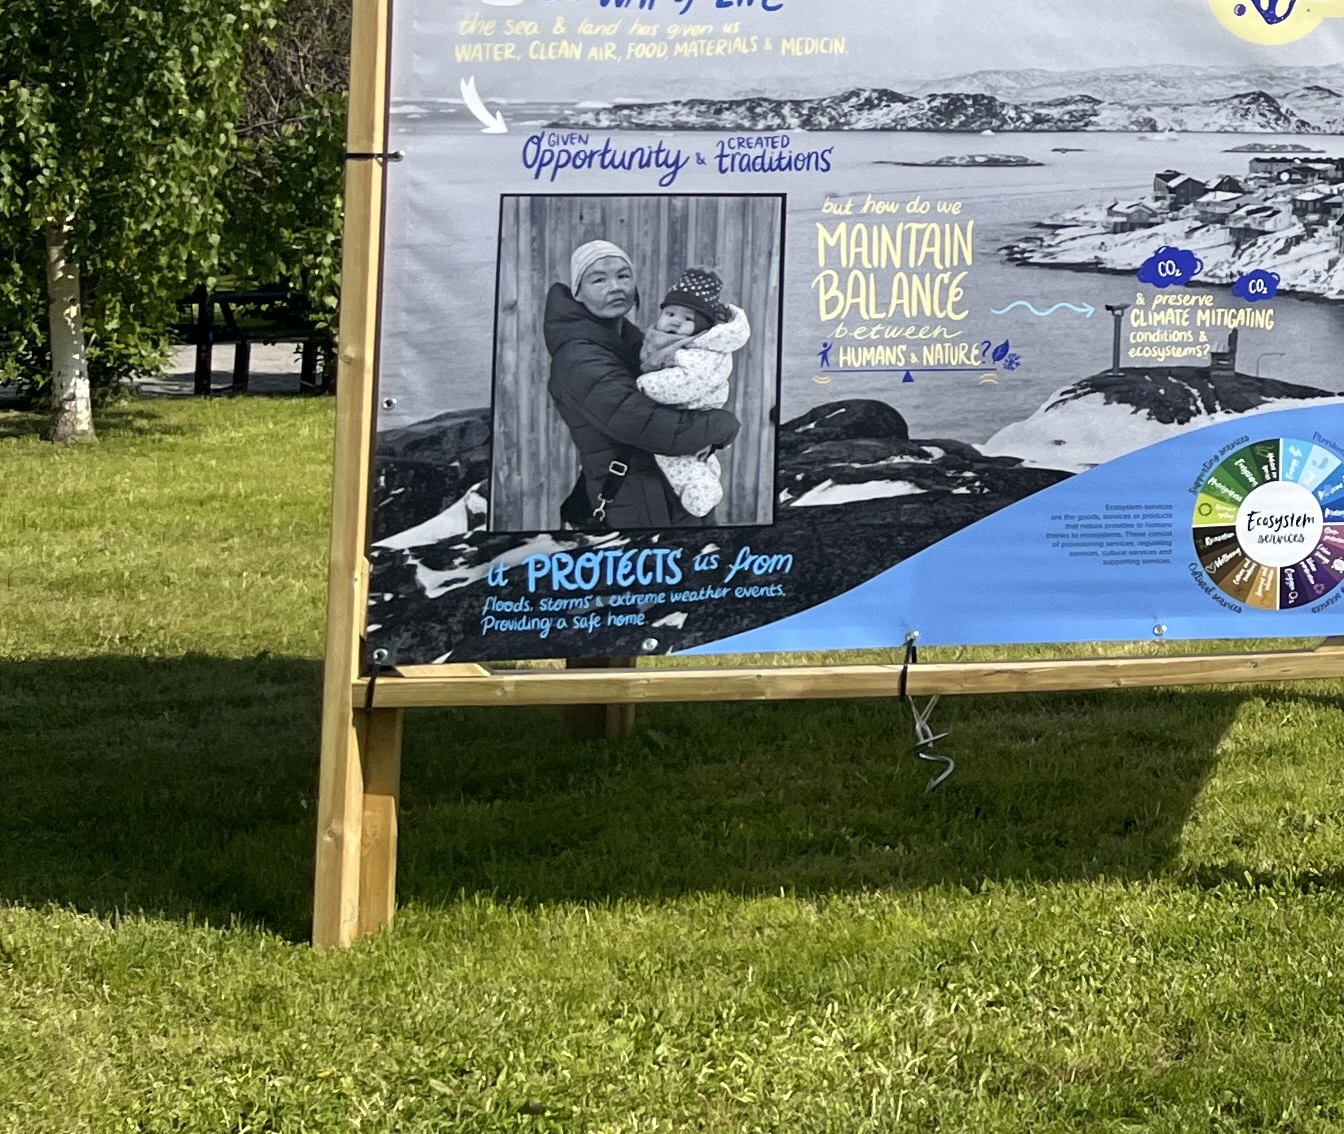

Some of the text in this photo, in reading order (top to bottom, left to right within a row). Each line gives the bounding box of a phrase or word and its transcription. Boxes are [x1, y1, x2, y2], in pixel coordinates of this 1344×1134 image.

[459, 11, 741, 41] the sea & land has given us
[455, 41, 521, 62] WATER,
[529, 40, 583, 61] CLEAN
[674, 35, 758, 59] MATERIALS
[763, 37, 773, 51] &
[548, 133, 589, 148] GIVEN
[727, 134, 790, 150] CREATED
[696, 152, 707, 166] &
[714, 140, 835, 174] traditions
[821, 194, 962, 215] but how do we
[815, 219, 975, 269] MAINTAIN
[811, 269, 969, 322] BALANCE
[1136, 292, 1214, 310] & preserve
[1131, 308, 1275, 330] CLIMATE MITIGATING
[827, 322, 963, 340] between
[1130, 329, 1208, 343] conditions &
[839, 345, 907, 368] HUMANS
[910, 352, 919, 364] &
[1128, 344, 1210, 362] ecosystems?
[1247, 510, 1315, 532] Ecosystem
[1257, 531, 1305, 545] services
[522, 547, 683, 594] PROTECTS
[693, 552, 719, 572] us
[724, 546, 794, 583] from
[539, 594, 592, 610] storms
[609, 592, 666, 608] extreme
[670, 585, 729, 602] weather
[481, 614, 553, 638] Providing
[557, 617, 568, 629] a
[573, 612, 602, 631] safe
